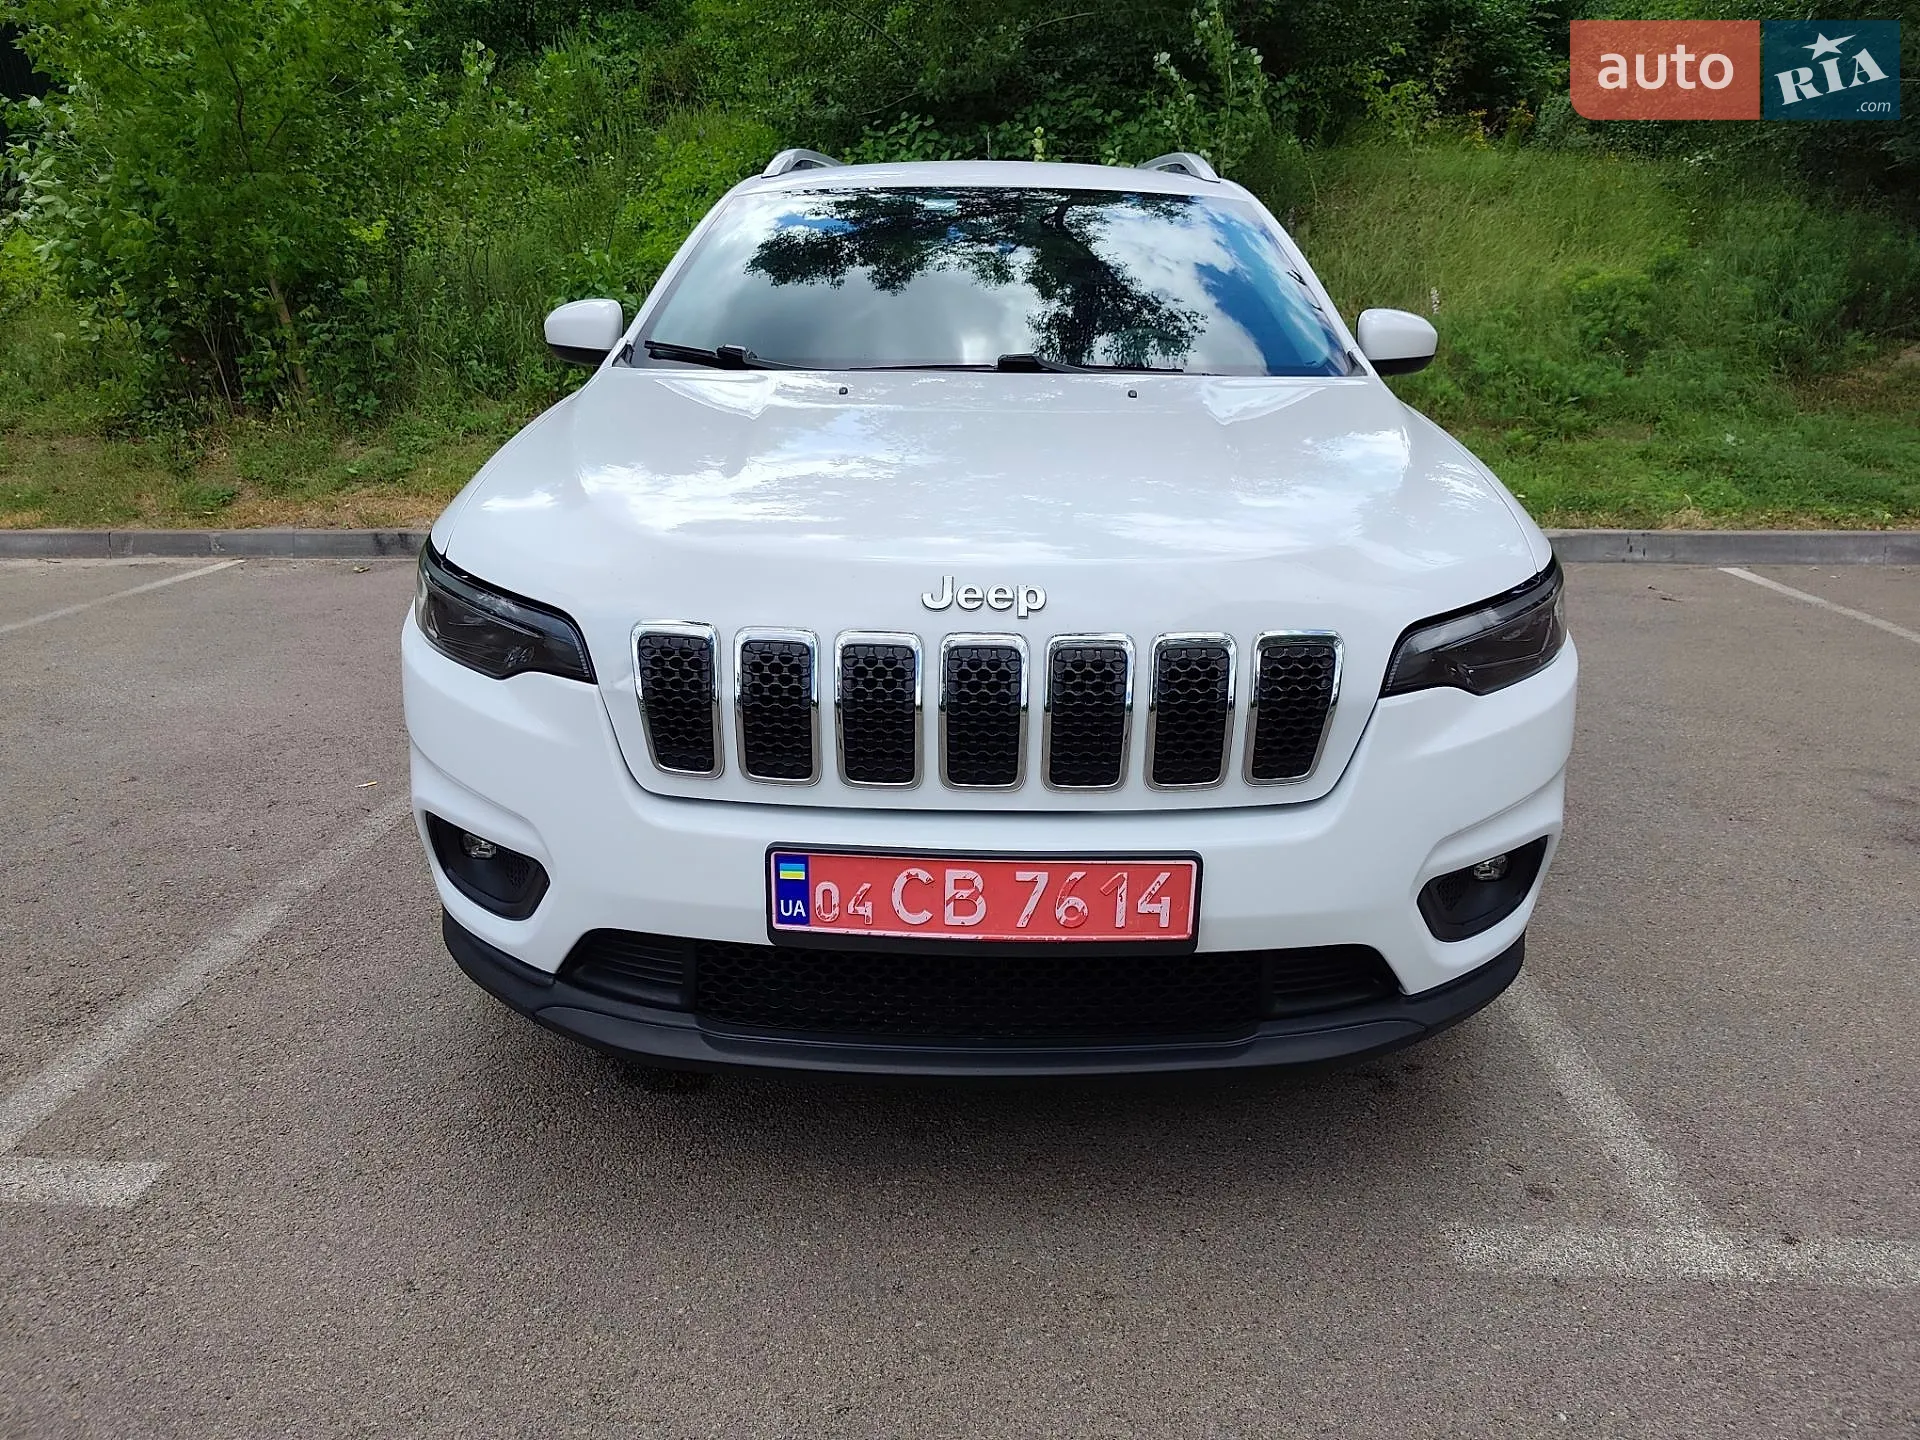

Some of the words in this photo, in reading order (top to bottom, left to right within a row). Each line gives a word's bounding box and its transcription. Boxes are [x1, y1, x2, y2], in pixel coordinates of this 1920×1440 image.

[921, 575, 1047, 619] Jeep
[780, 899, 807, 918] UA
[815, 880, 874, 925] 04
[891, 867, 987, 928] CB
[1015, 871, 1172, 928] 7614
